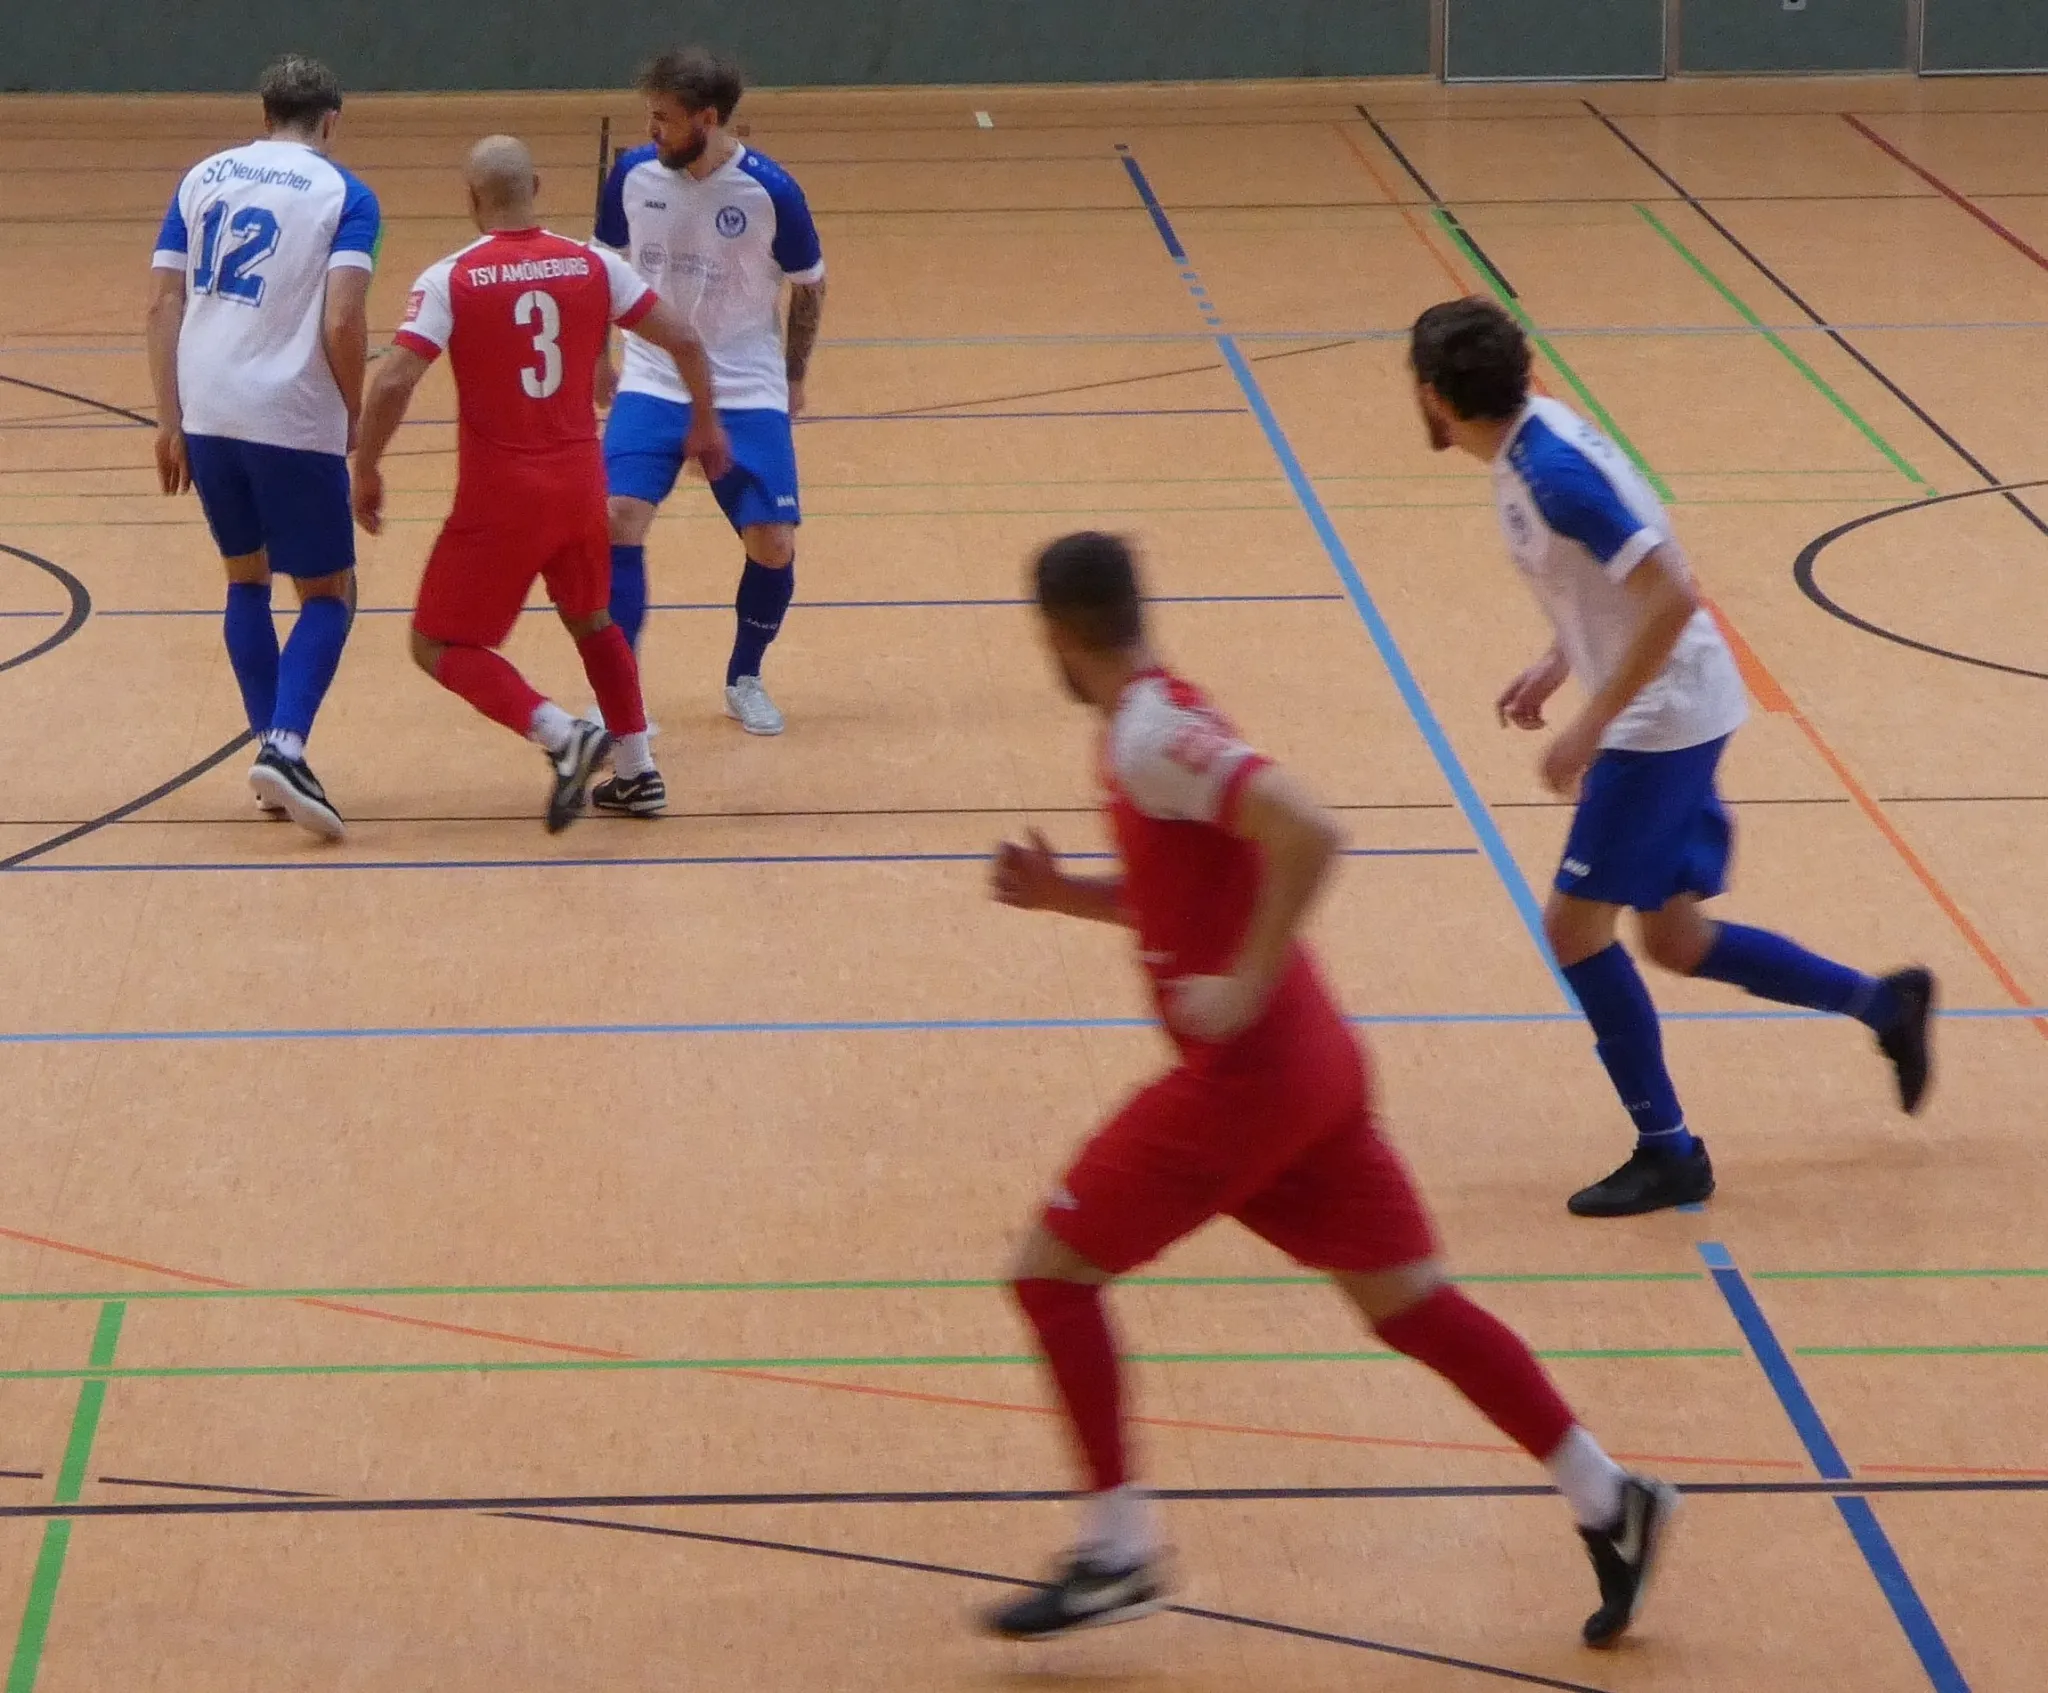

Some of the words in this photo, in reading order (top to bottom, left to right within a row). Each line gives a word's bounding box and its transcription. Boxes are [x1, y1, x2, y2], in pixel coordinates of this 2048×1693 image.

[203, 158, 233, 185] SC
[231, 162, 312, 192] Neukirchen
[193, 199, 281, 308] 12
[468, 268, 498, 287] TSV
[501, 257, 590, 283] AMÖNEBURG
[513, 290, 563, 399] 3
